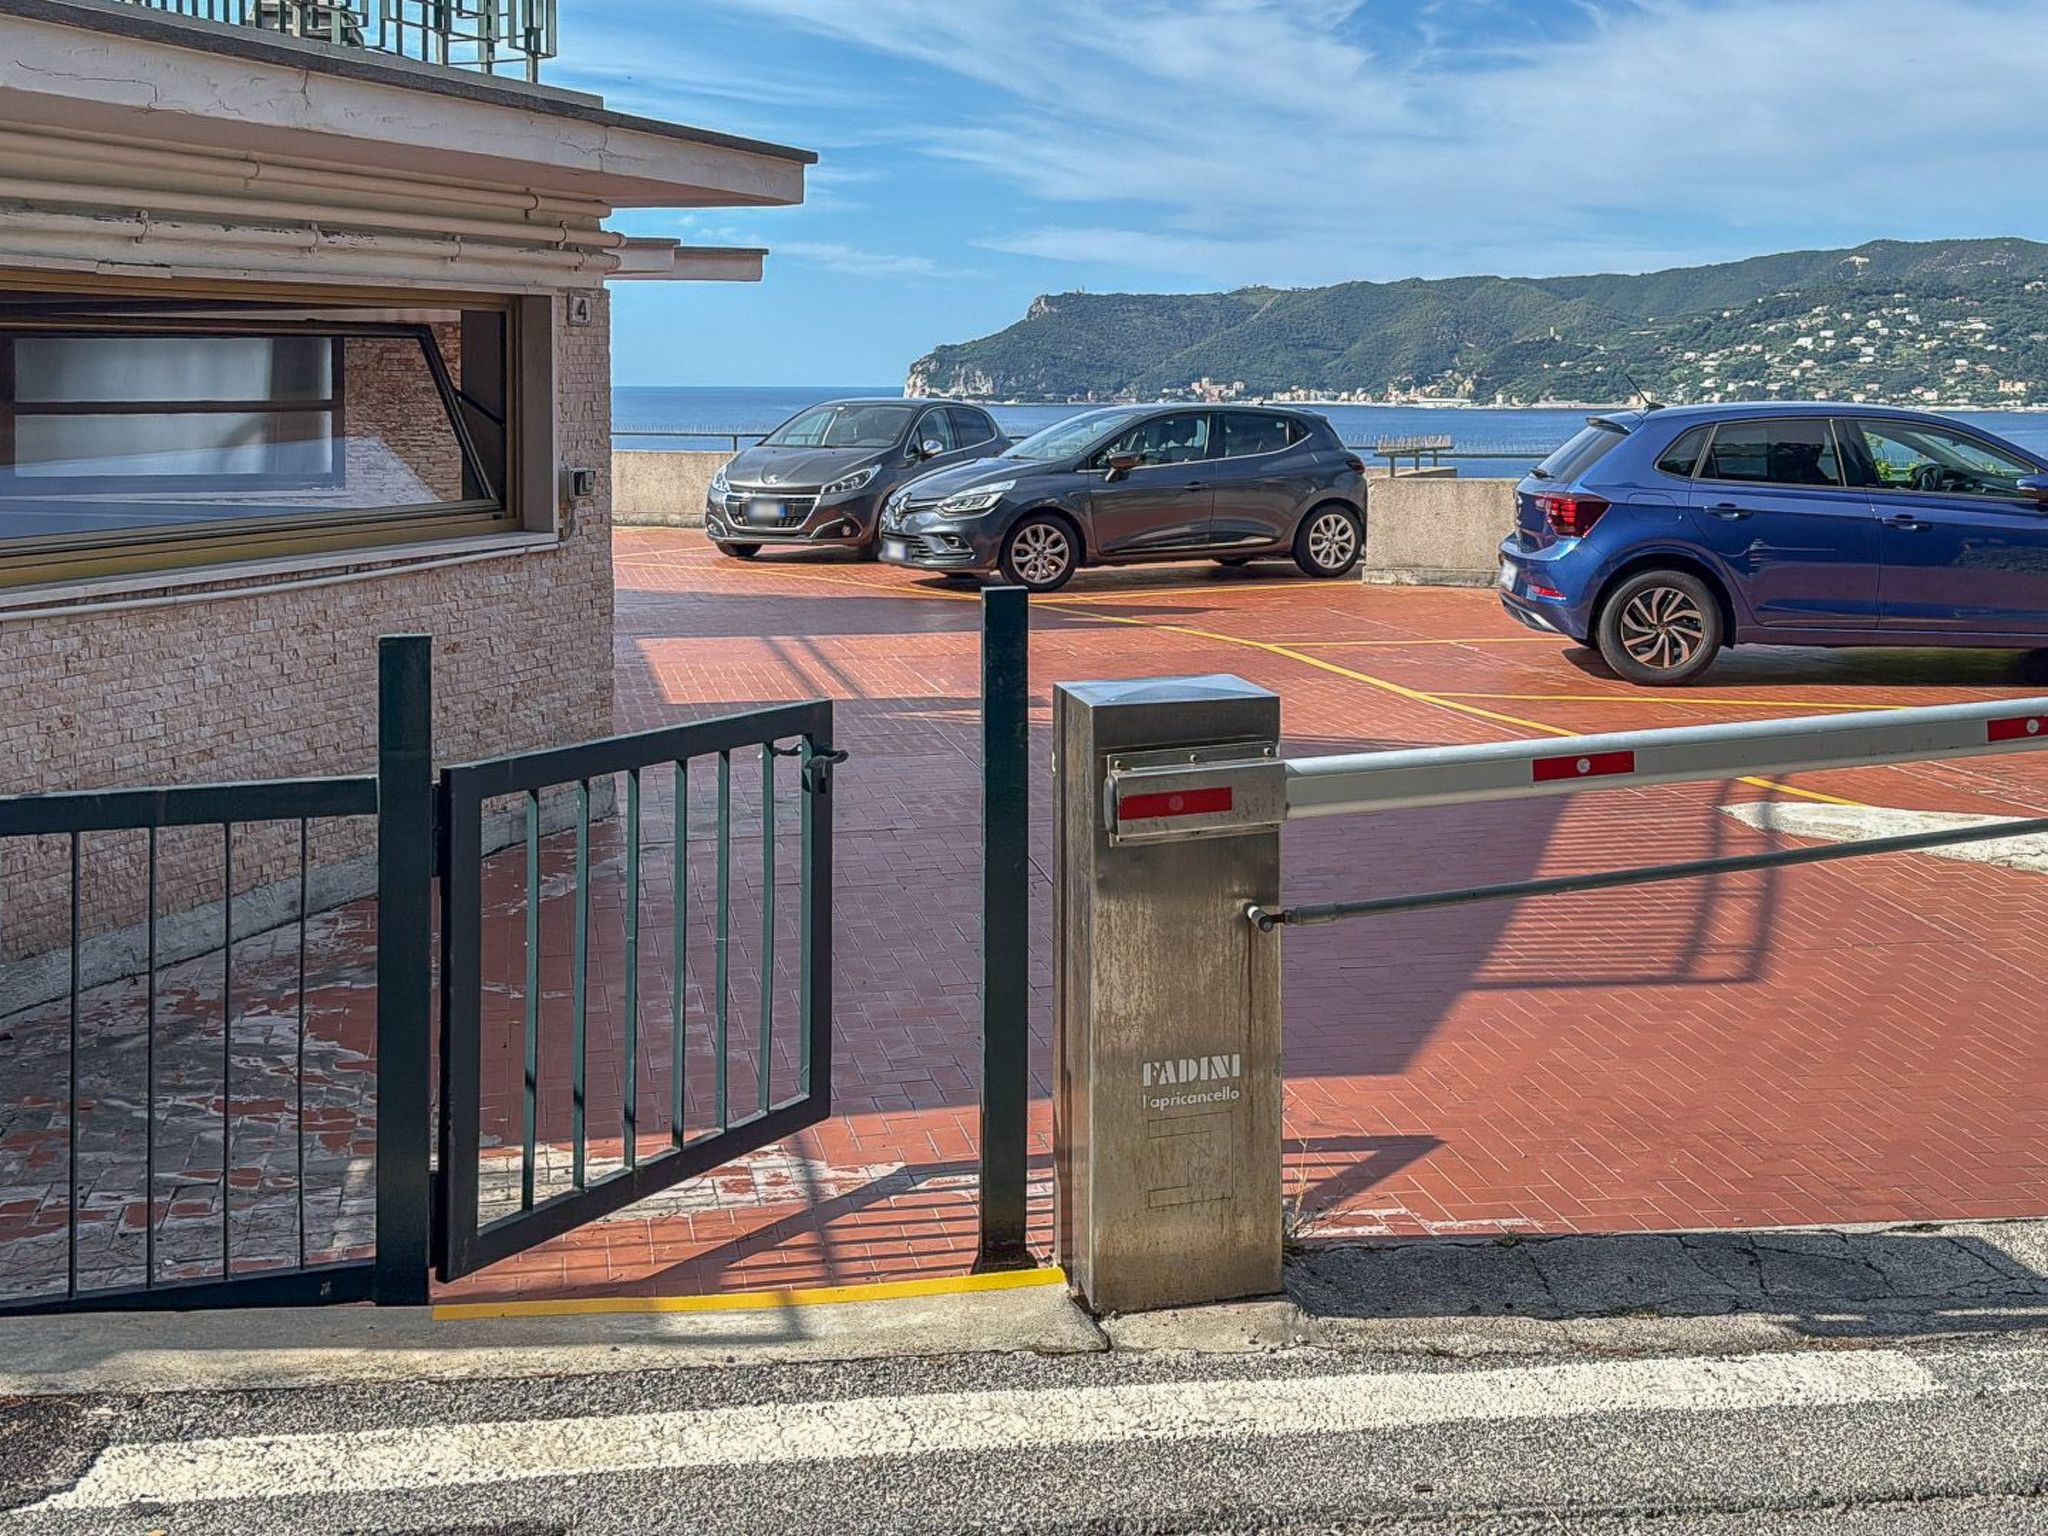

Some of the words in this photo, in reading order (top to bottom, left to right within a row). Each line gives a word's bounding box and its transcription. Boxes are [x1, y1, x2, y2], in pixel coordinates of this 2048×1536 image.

[576, 299, 587, 320] 4
[1142, 1054, 1241, 1087] FADINI
[1142, 1086, 1240, 1111] l'apricancello
